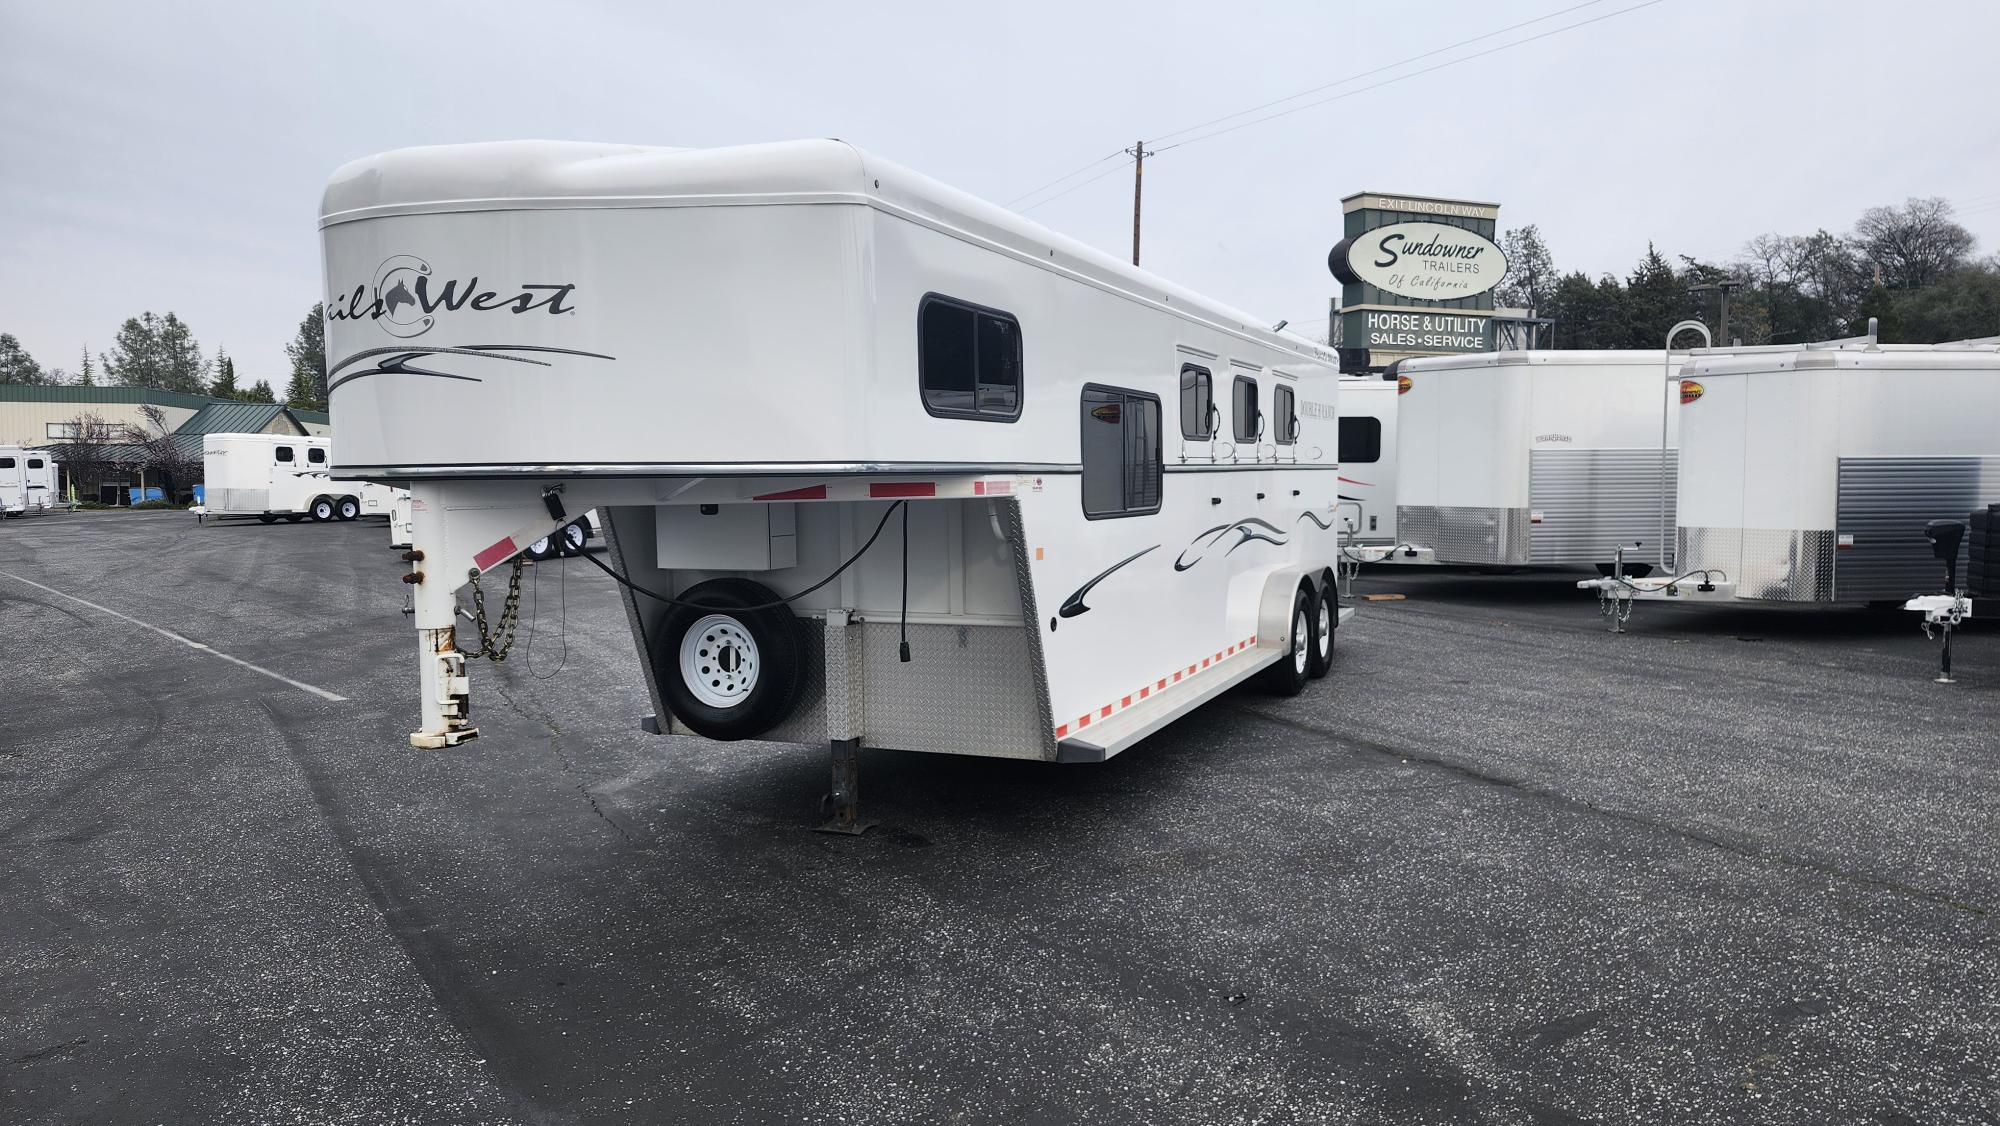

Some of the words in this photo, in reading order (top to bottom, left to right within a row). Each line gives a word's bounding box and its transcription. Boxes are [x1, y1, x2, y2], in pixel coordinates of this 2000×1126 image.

[1378, 198, 1406, 209] EXIT
[1408, 201, 1459, 215] LINCOLN
[1462, 206, 1486, 217] WAY
[1374, 233, 1485, 267] Sundowner
[1422, 260, 1480, 274] TRAILERS
[1388, 274, 1405, 289] Of
[1410, 275, 1469, 291] California
[325, 284, 387, 322] ails
[415, 276, 576, 316] West
[1368, 313, 1419, 330] HORSE
[1423, 316, 1432, 331] &
[1435, 316, 1486, 333] UTILITY
[1370, 333, 1416, 346] SALES
[1423, 335, 1484, 348] SERVICE
